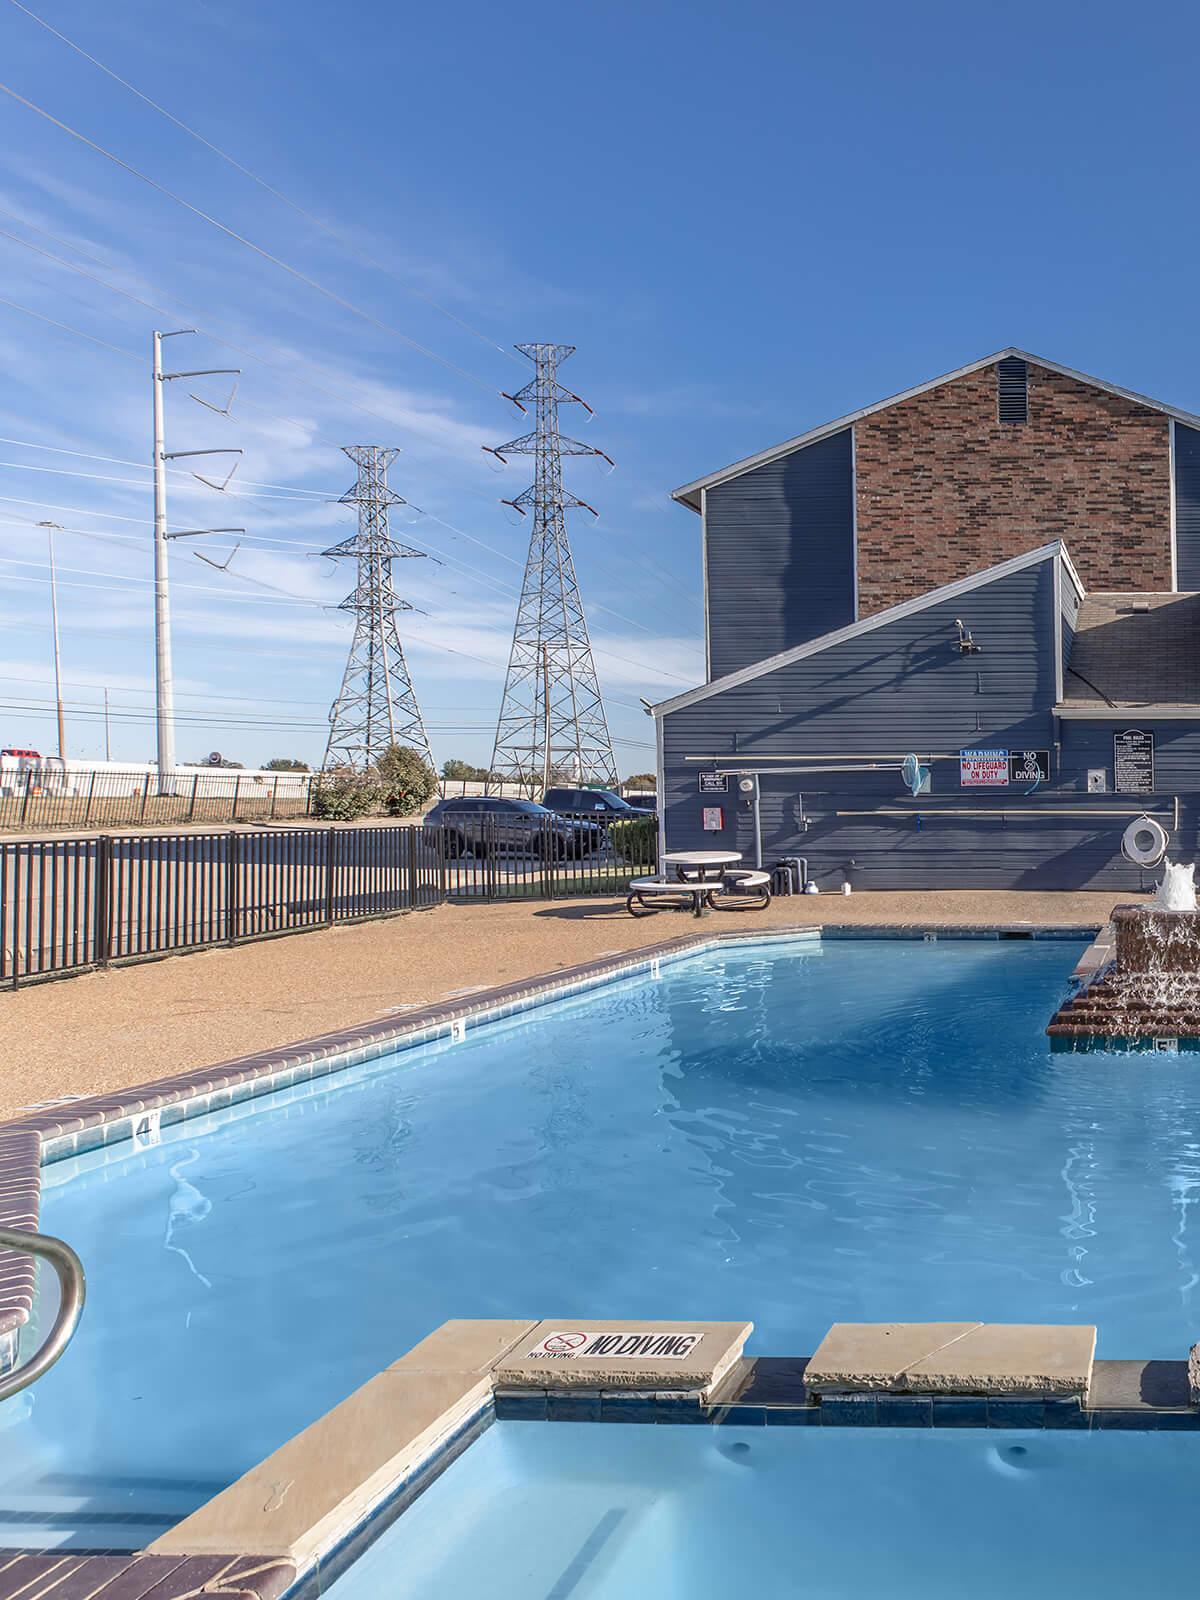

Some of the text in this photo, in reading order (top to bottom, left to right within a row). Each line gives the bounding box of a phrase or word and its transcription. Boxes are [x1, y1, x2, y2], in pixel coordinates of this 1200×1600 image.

[1023, 752, 1036, 760] NO
[962, 762, 1007, 770] NO LIFEGUARD
[1015, 771, 1045, 779] DIVING
[453, 1022, 460, 1041] 5
[136, 1116, 152, 1136] 4
[584, 1335, 697, 1355] NO DIVING
[527, 1351, 576, 1359] NO DIVING
